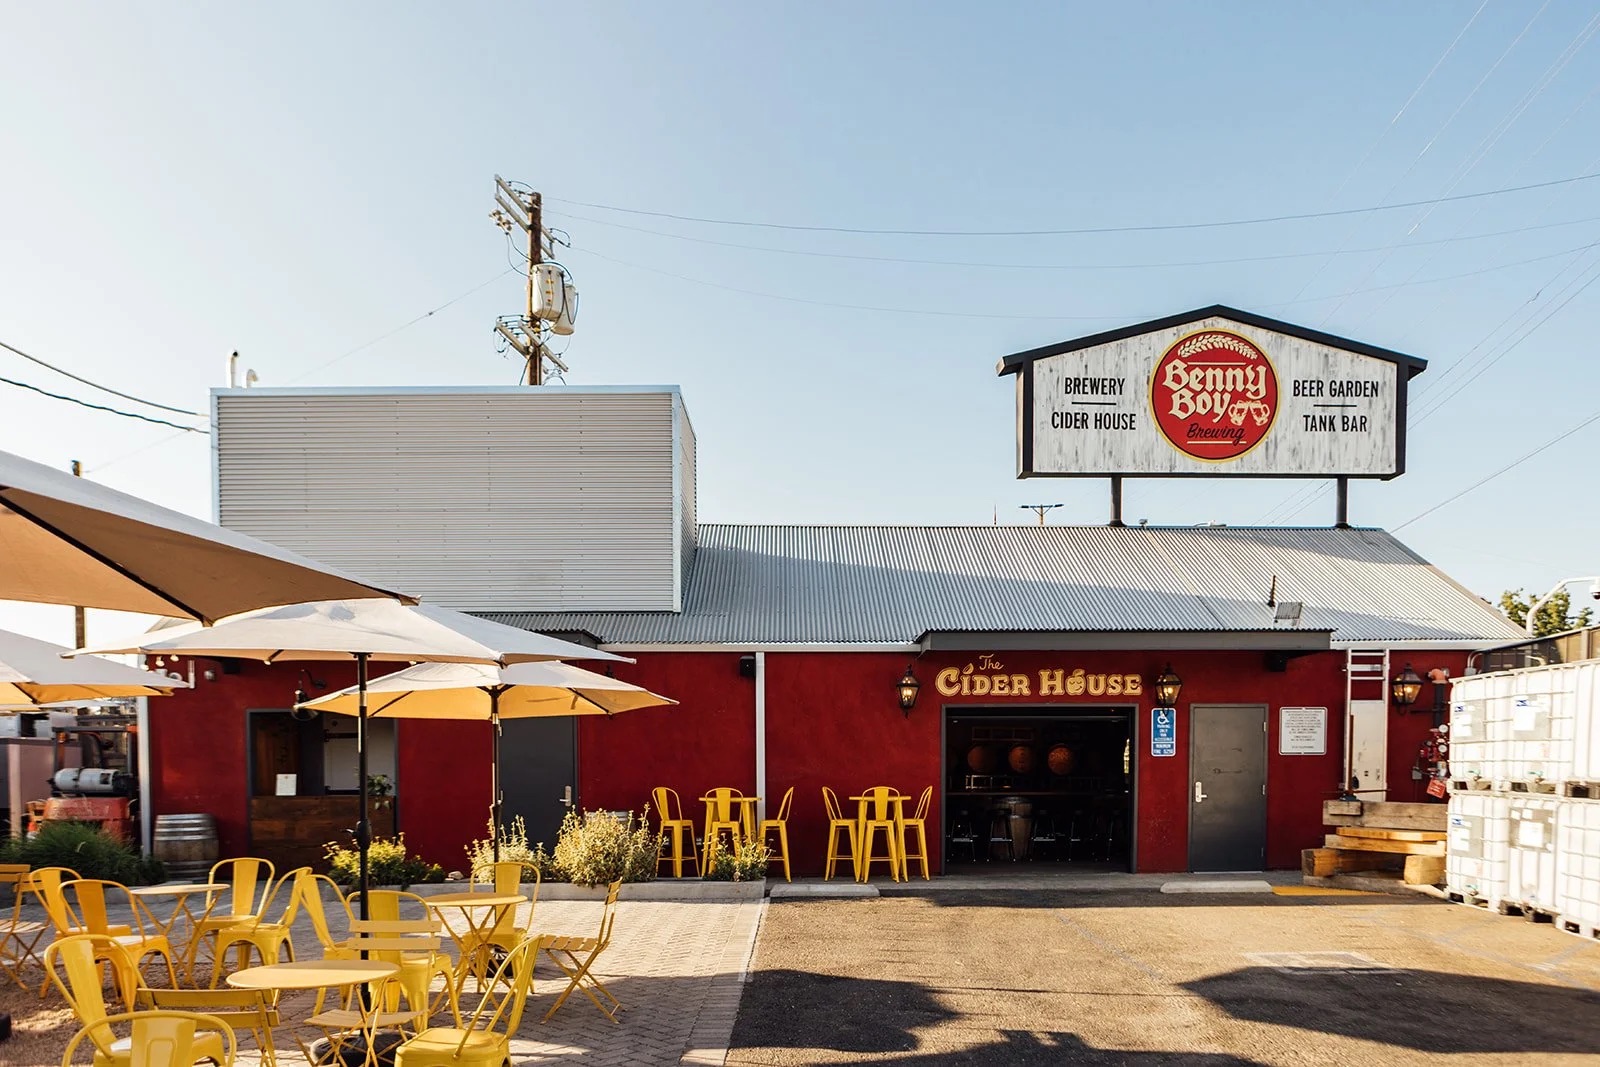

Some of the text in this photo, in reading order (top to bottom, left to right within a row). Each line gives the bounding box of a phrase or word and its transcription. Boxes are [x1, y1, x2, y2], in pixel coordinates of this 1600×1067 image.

[1064, 377, 1126, 396] BREWERY
[1162, 358, 1267, 400] Benny
[1292, 379, 1379, 398] BEER GARDEN
[1168, 387, 1232, 423] Boy
[1051, 411, 1137, 431] CIDER HOUSE
[1302, 414, 1368, 432] TANK BAR
[1186, 422, 1246, 446] Brewing
[978, 653, 1005, 671] The
[934, 664, 1143, 697] CIDER HOUSE
